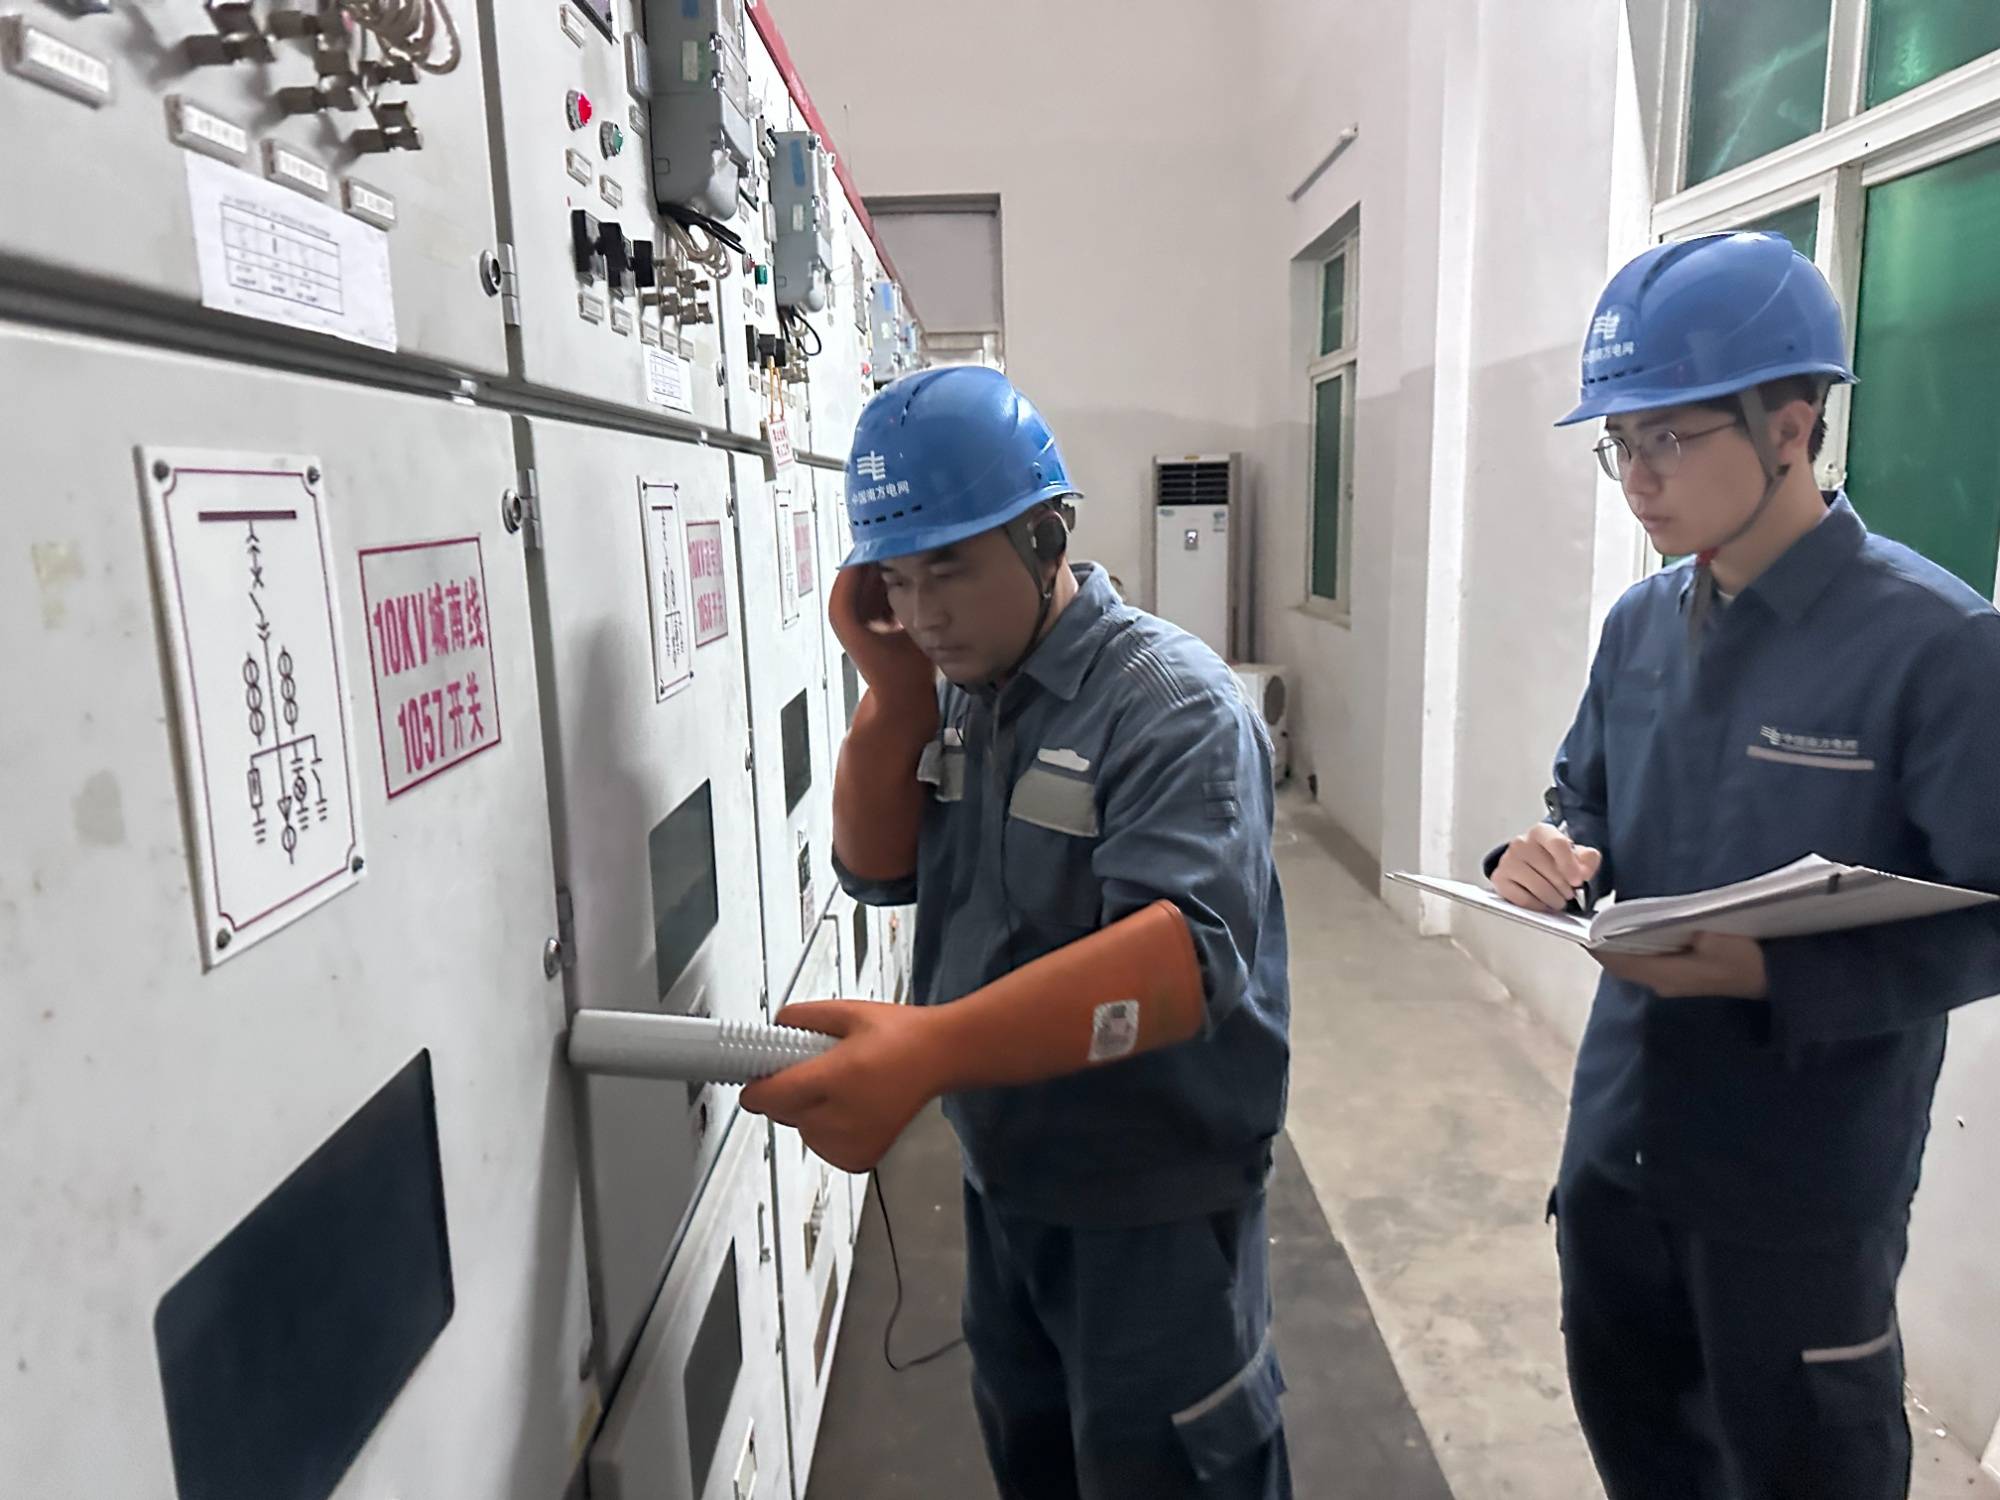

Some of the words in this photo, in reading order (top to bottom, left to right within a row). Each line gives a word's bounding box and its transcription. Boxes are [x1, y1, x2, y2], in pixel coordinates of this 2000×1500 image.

[373, 576, 484, 676] 10KV城南线
[398, 671, 484, 774] 1057开关
